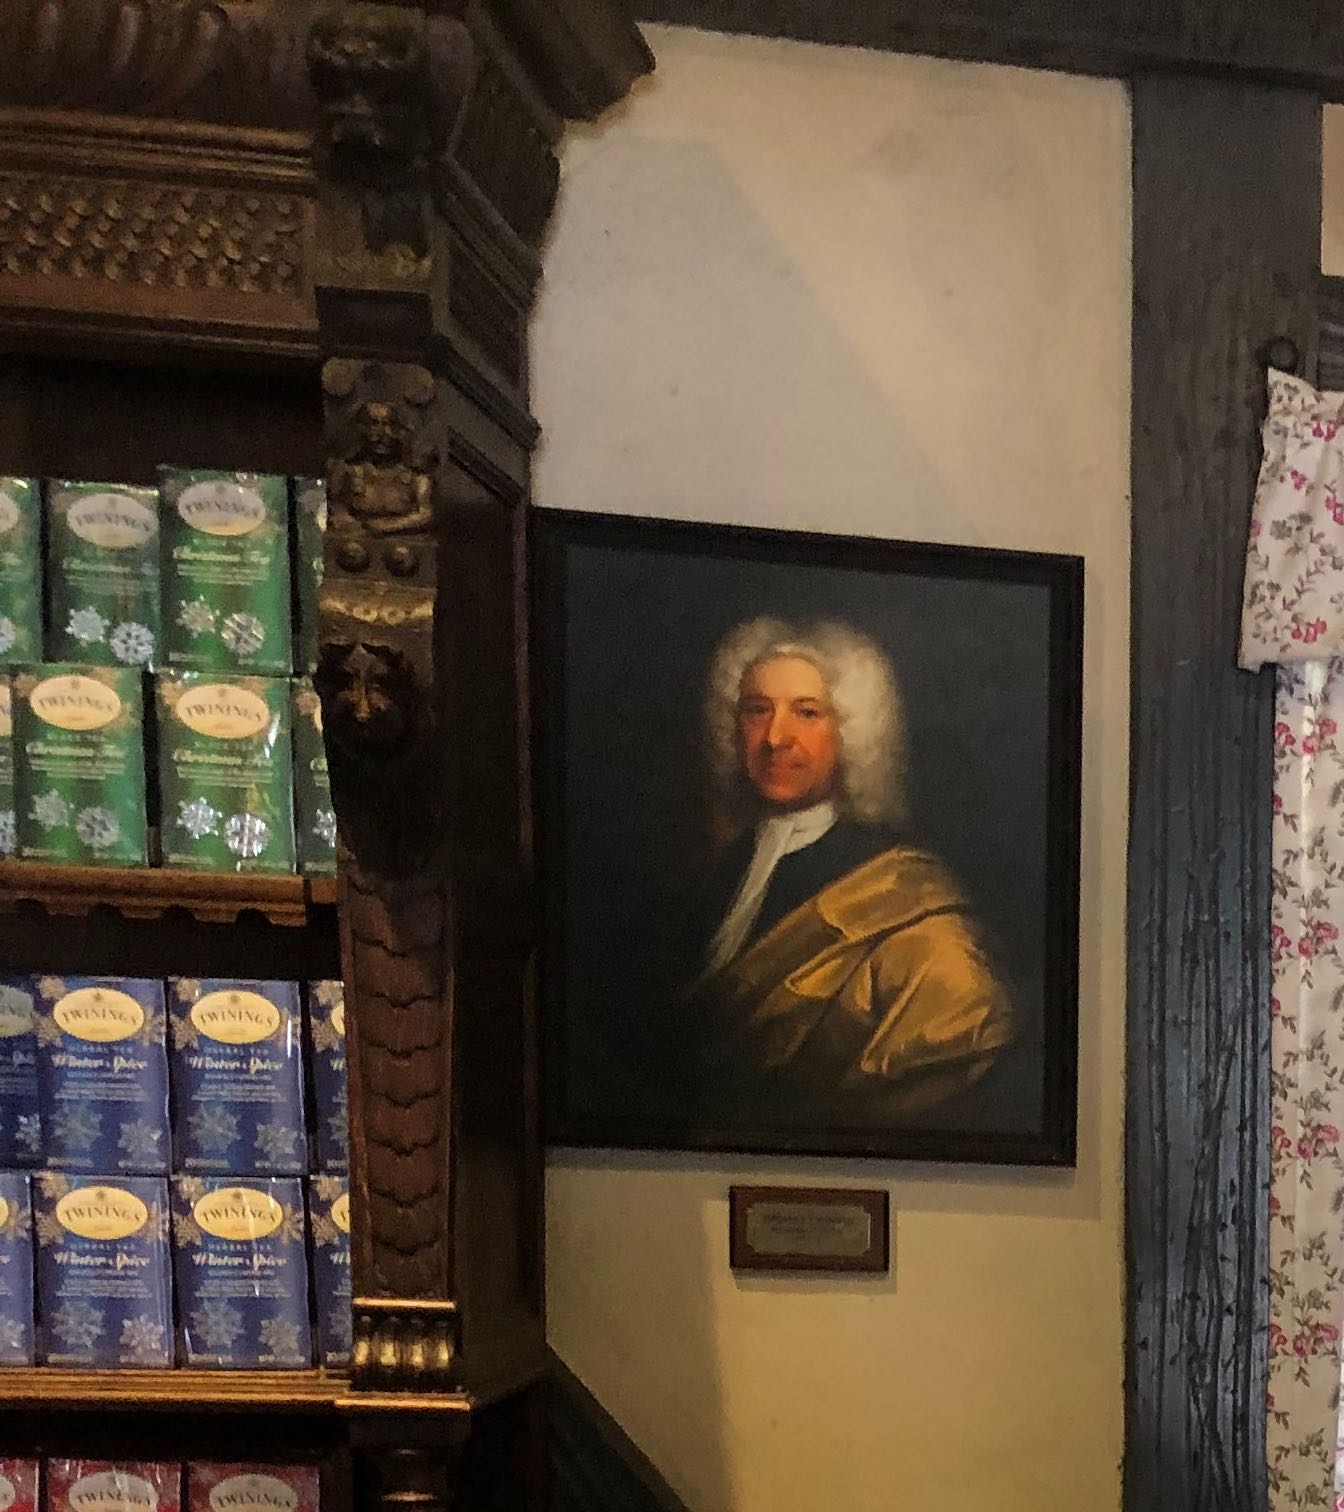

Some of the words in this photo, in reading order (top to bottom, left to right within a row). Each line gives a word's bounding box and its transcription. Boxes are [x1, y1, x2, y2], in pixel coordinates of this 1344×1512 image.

[61, 1007, 140, 1025] TWININGS
[198, 1008, 275, 1027] TWININGS
[62, 1203, 143, 1224] TWININGS
